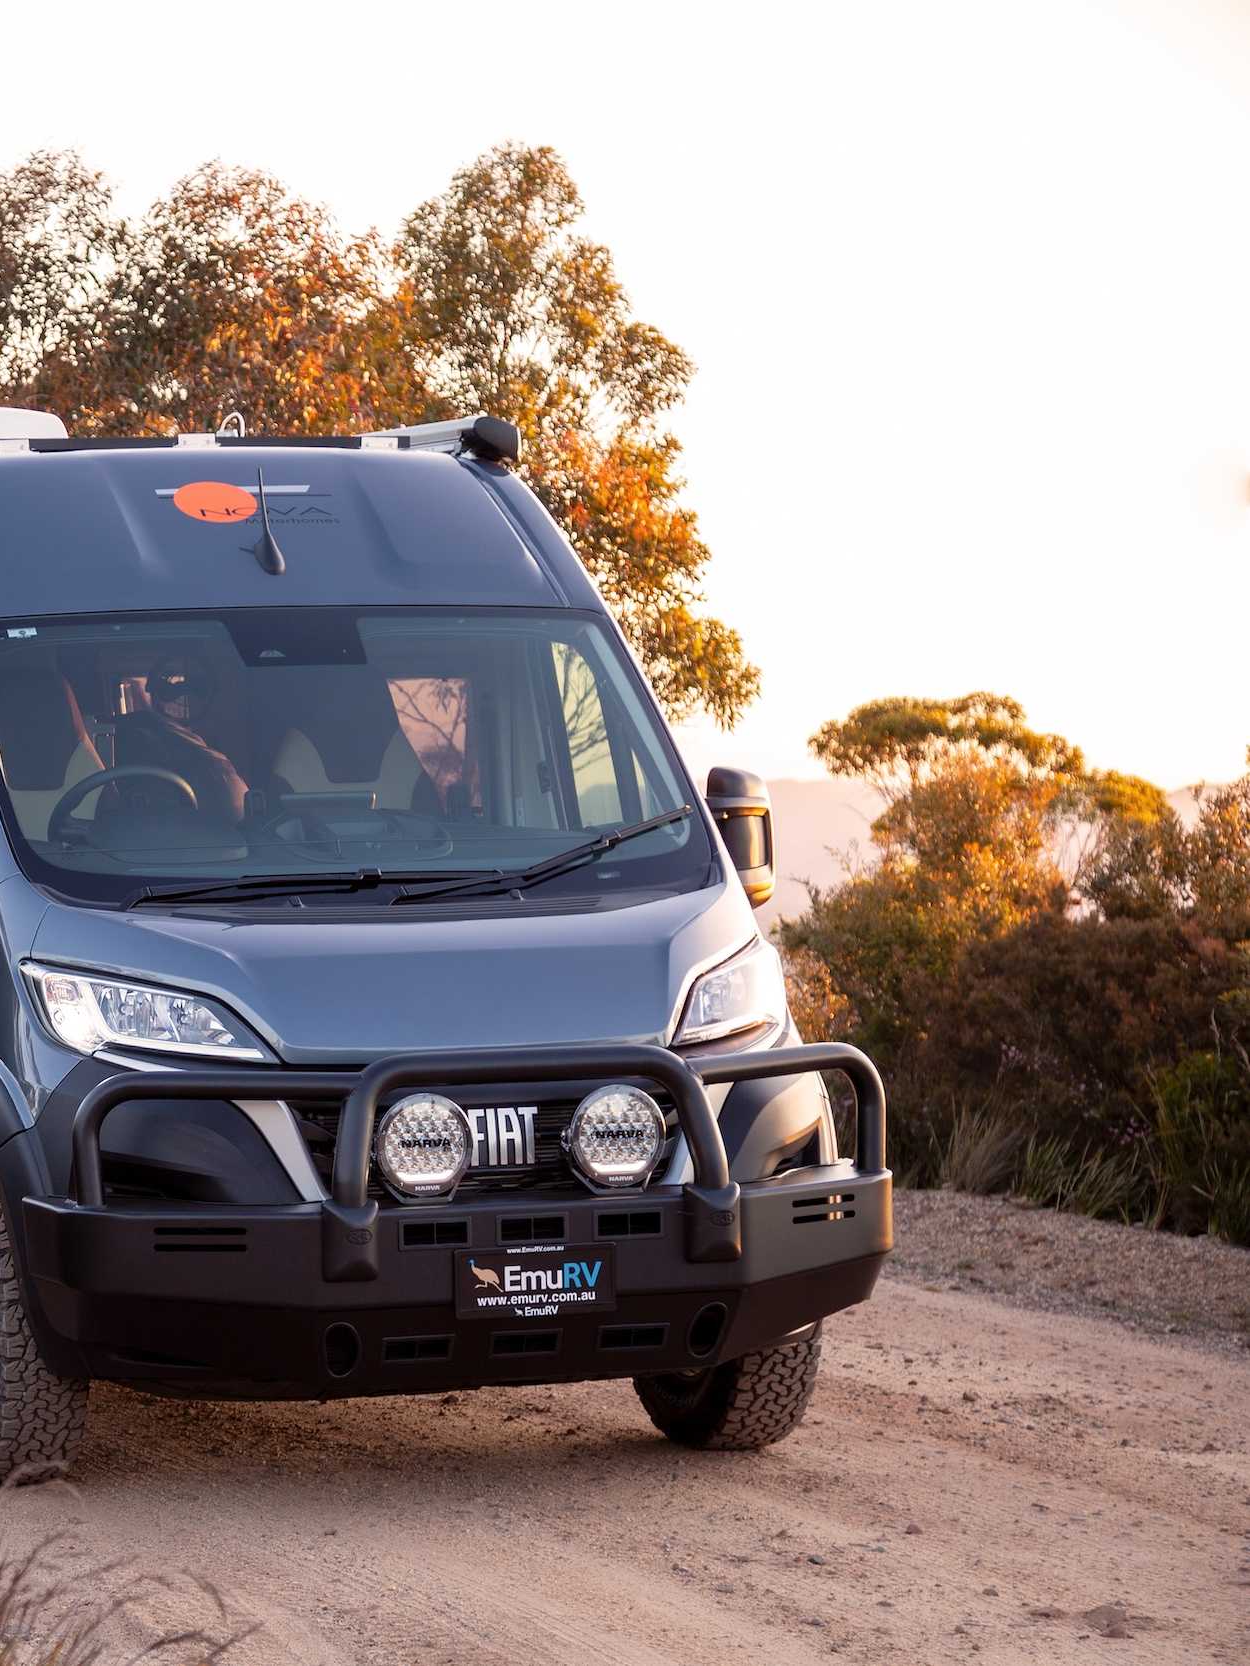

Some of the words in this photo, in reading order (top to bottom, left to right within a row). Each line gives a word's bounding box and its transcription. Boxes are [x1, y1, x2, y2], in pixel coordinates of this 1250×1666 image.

[199, 506, 332, 517] NOVA
[245, 517, 340, 525] Mtorhomes
[467, 1107, 538, 1166] FIAT
[595, 1130, 643, 1138] NARVA
[401, 1138, 451, 1148] NARVA
[414, 1184, 440, 1192] NARVA
[504, 1261, 602, 1292] EmuRV
[477, 1291, 596, 1306] www.emurv.com.au
[524, 1305, 559, 1317] EmuRV
